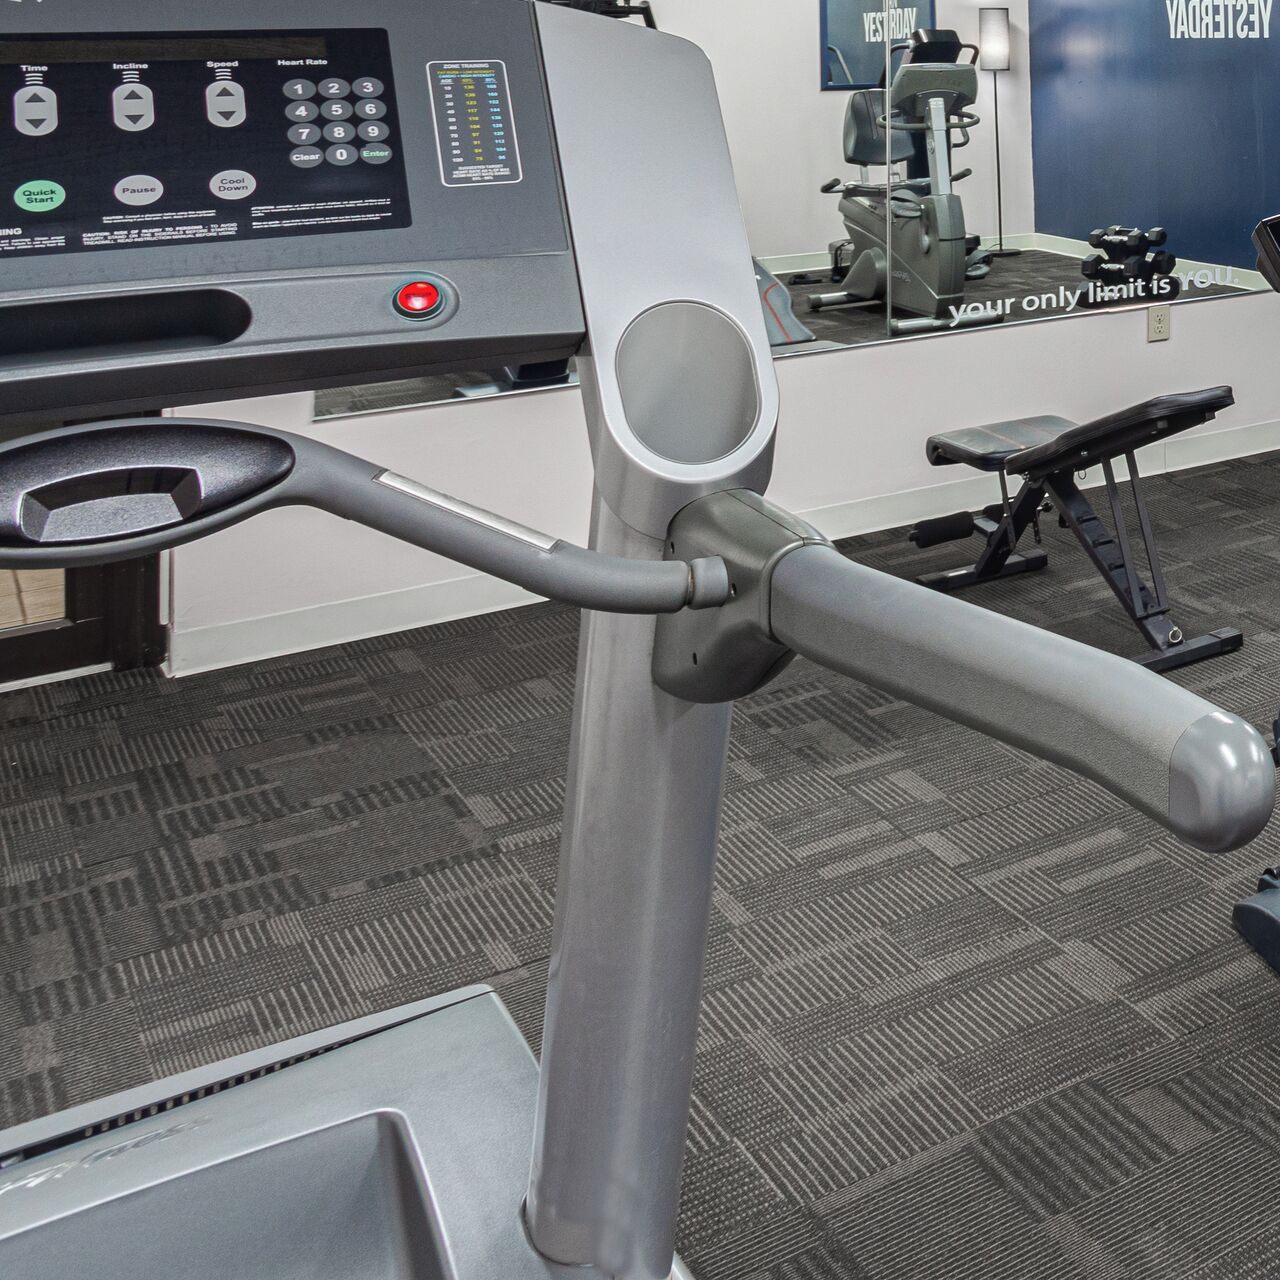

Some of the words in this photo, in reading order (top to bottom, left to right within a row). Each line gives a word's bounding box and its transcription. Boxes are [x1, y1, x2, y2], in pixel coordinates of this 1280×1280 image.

[863, 7, 917, 42] YESTRDAY
[206, 60, 240, 68] Speed
[277, 58, 304, 66] Heart
[293, 84, 303, 95] 1
[328, 83, 340, 93] 2
[362, 82, 374, 93] 3
[295, 106, 308, 117] 4
[331, 104, 343, 115] 5
[365, 103, 377, 114] 6
[299, 129, 310, 140] 7
[333, 127, 345, 138] 8
[367, 126, 379, 137] 9
[292, 153, 321, 161] Clear
[336, 149, 347, 160] 0
[22, 189, 57, 198] Quick
[122, 186, 156, 194] Pause
[218, 184, 249, 192] Down
[26, 196, 54, 204] Start
[949, 297, 1016, 327] your
[1022, 285, 1081, 312] only
[1088, 277, 1147, 304] limit
[1152, 274, 1171, 295] is
